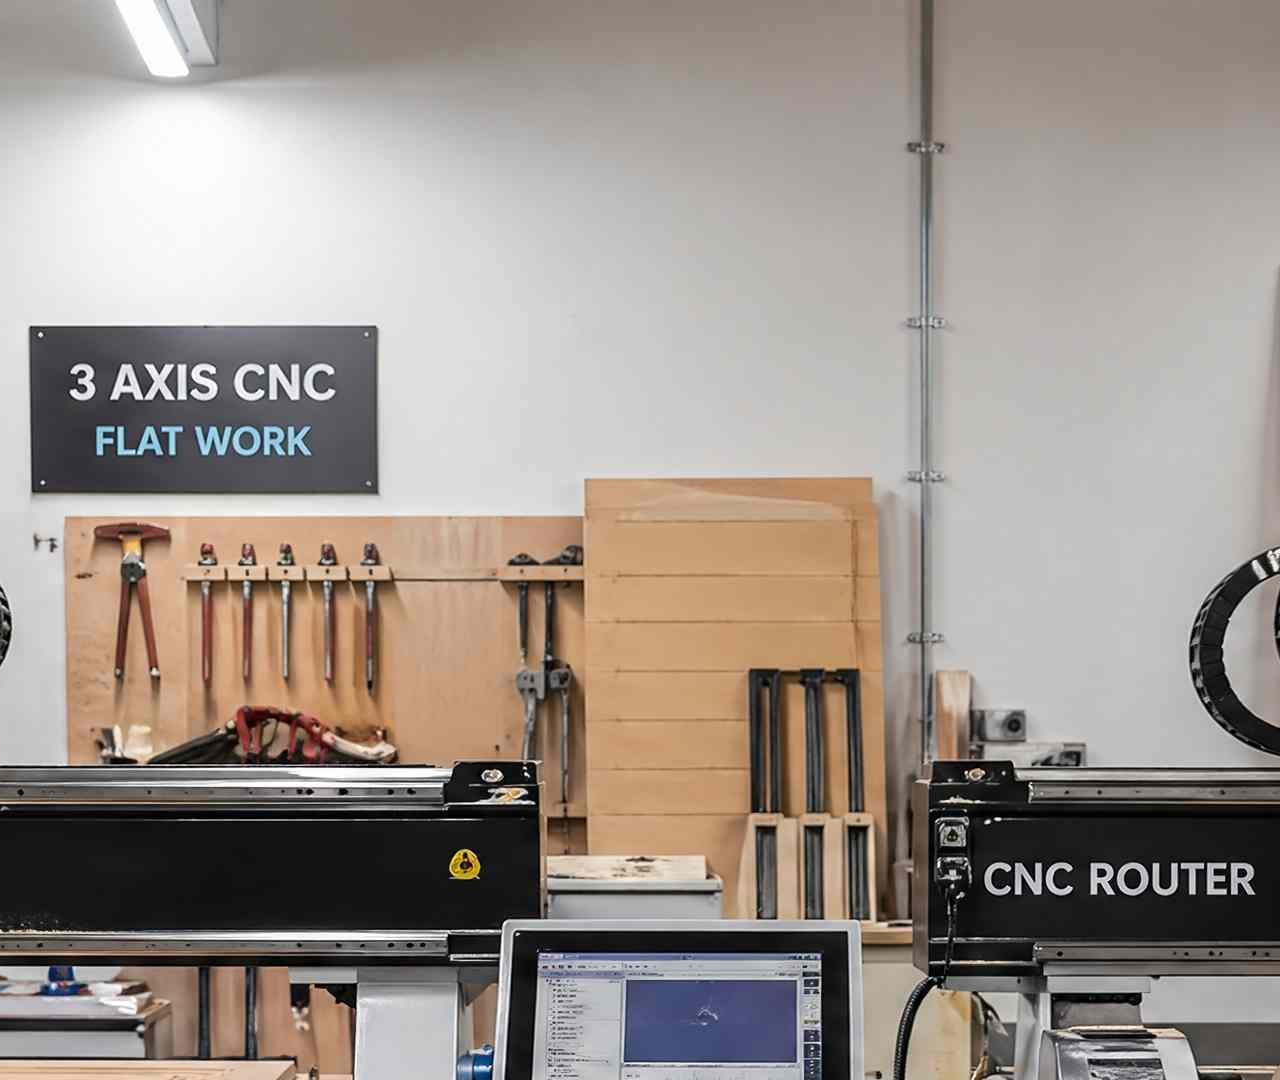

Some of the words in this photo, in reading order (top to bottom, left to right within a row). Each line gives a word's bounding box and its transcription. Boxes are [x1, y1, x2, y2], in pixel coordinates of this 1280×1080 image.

[69, 363, 96, 401] 3
[110, 363, 219, 401] AXIS
[233, 363, 336, 401] CNC
[95, 425, 184, 456] FLAT
[194, 425, 312, 456] WORK
[983, 862, 1074, 896] CNC
[1089, 862, 1256, 897] ROUTER
